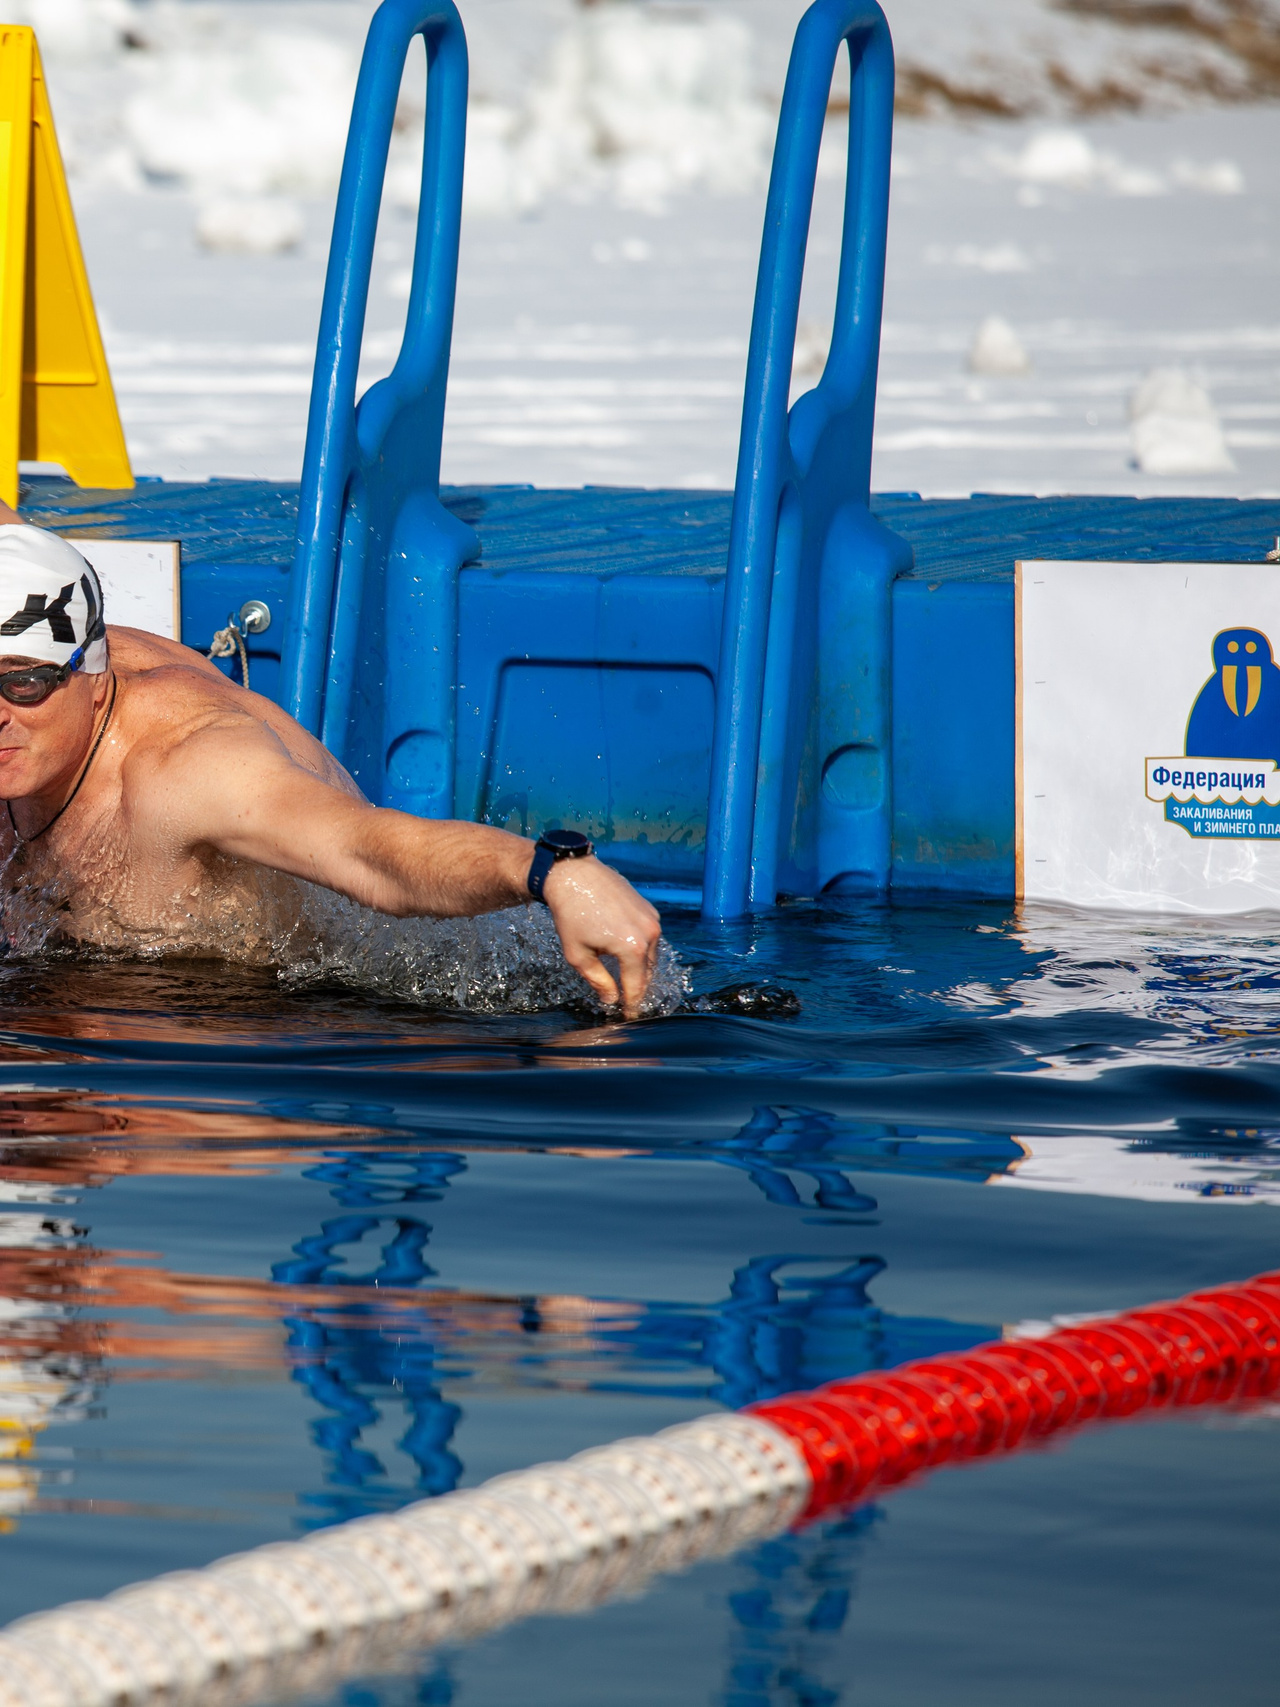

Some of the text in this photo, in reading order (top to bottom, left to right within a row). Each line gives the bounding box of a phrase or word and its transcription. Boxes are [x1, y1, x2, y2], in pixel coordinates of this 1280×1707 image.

[1152, 766, 1266, 791] Федерация
[1173, 806, 1253, 820] ЗАКАЛИВАНИЯ
[1193, 821, 1202, 833] И
[1204, 821, 1256, 835] ЗИМНЕГО
